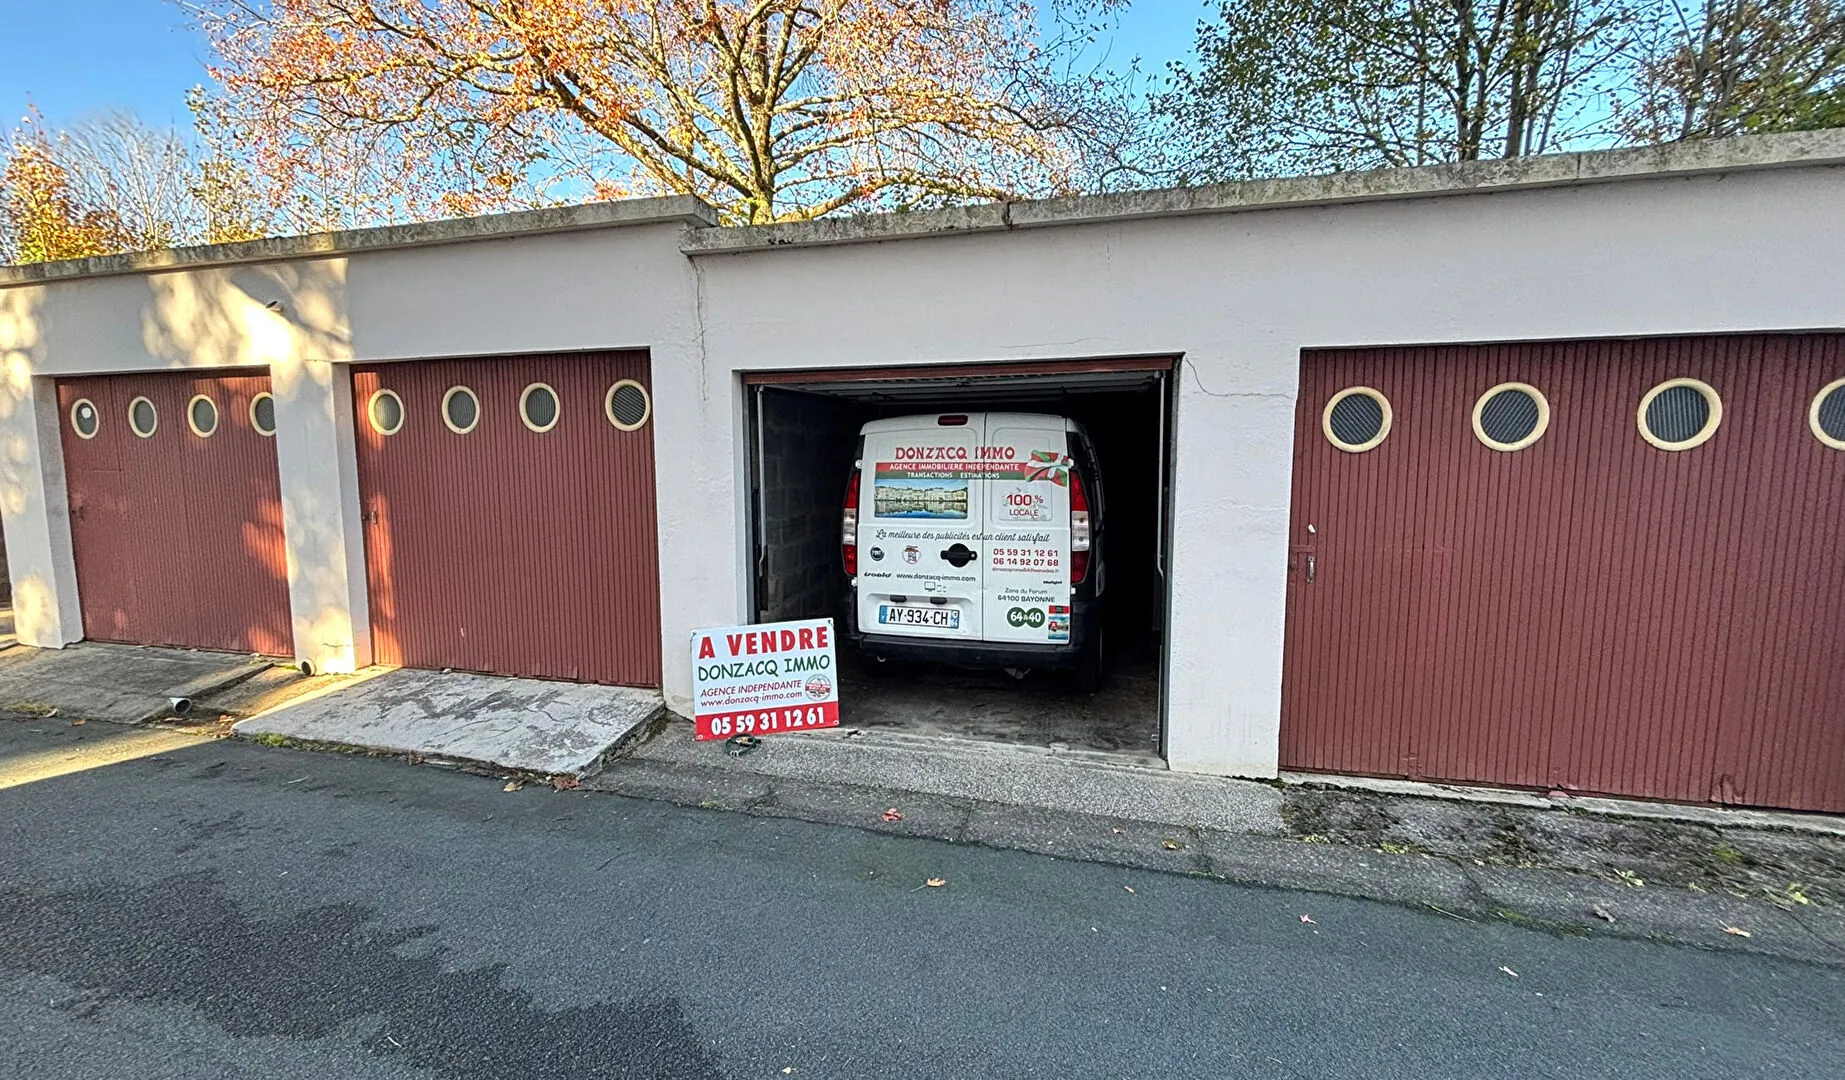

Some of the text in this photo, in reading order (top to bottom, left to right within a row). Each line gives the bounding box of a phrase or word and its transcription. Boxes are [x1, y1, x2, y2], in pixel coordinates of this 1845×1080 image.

[896, 447, 1015, 460] DONZACQ IMMO
[1007, 494, 1032, 506] 100
[876, 529, 886, 540] La
[699, 626, 828, 659] A VENDRE
[698, 655, 830, 681] DONZACQ IMMO
[700, 686, 736, 697] AGENCE
[738, 680, 802, 693] INDEPENDANTE
[701, 691, 802, 707] www.donzacq-immo.com
[711, 707, 824, 735] 05 59 31 12 61
